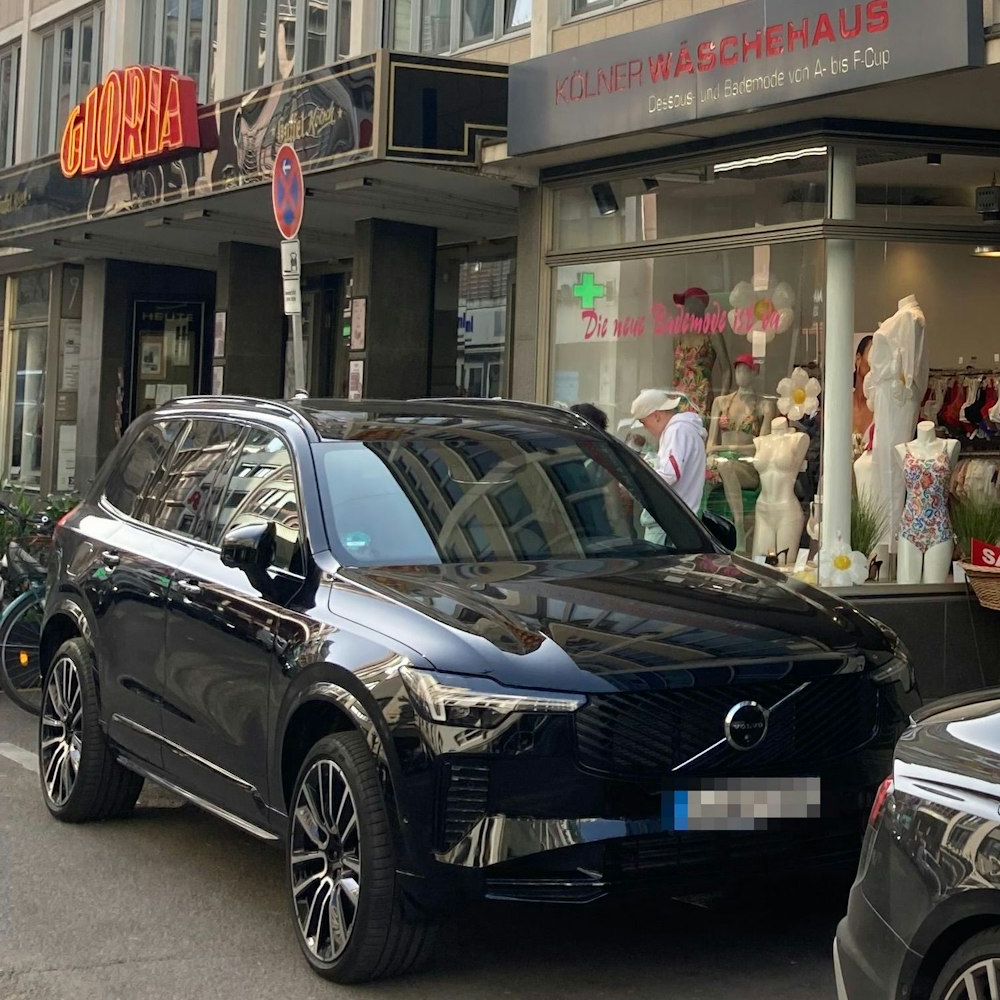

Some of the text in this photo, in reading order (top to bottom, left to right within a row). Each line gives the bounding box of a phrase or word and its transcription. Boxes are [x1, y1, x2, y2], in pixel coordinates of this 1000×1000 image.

[555, 59, 644, 105] KÖLNER
[648, 46, 891, 113] Dessous- und Bademode von A- bis F-Cup
[60, 65, 184, 178] GLORIA
[581, 310, 608, 340] Die
[613, 316, 645, 338] neue
[651, 302, 727, 337] Bademode
